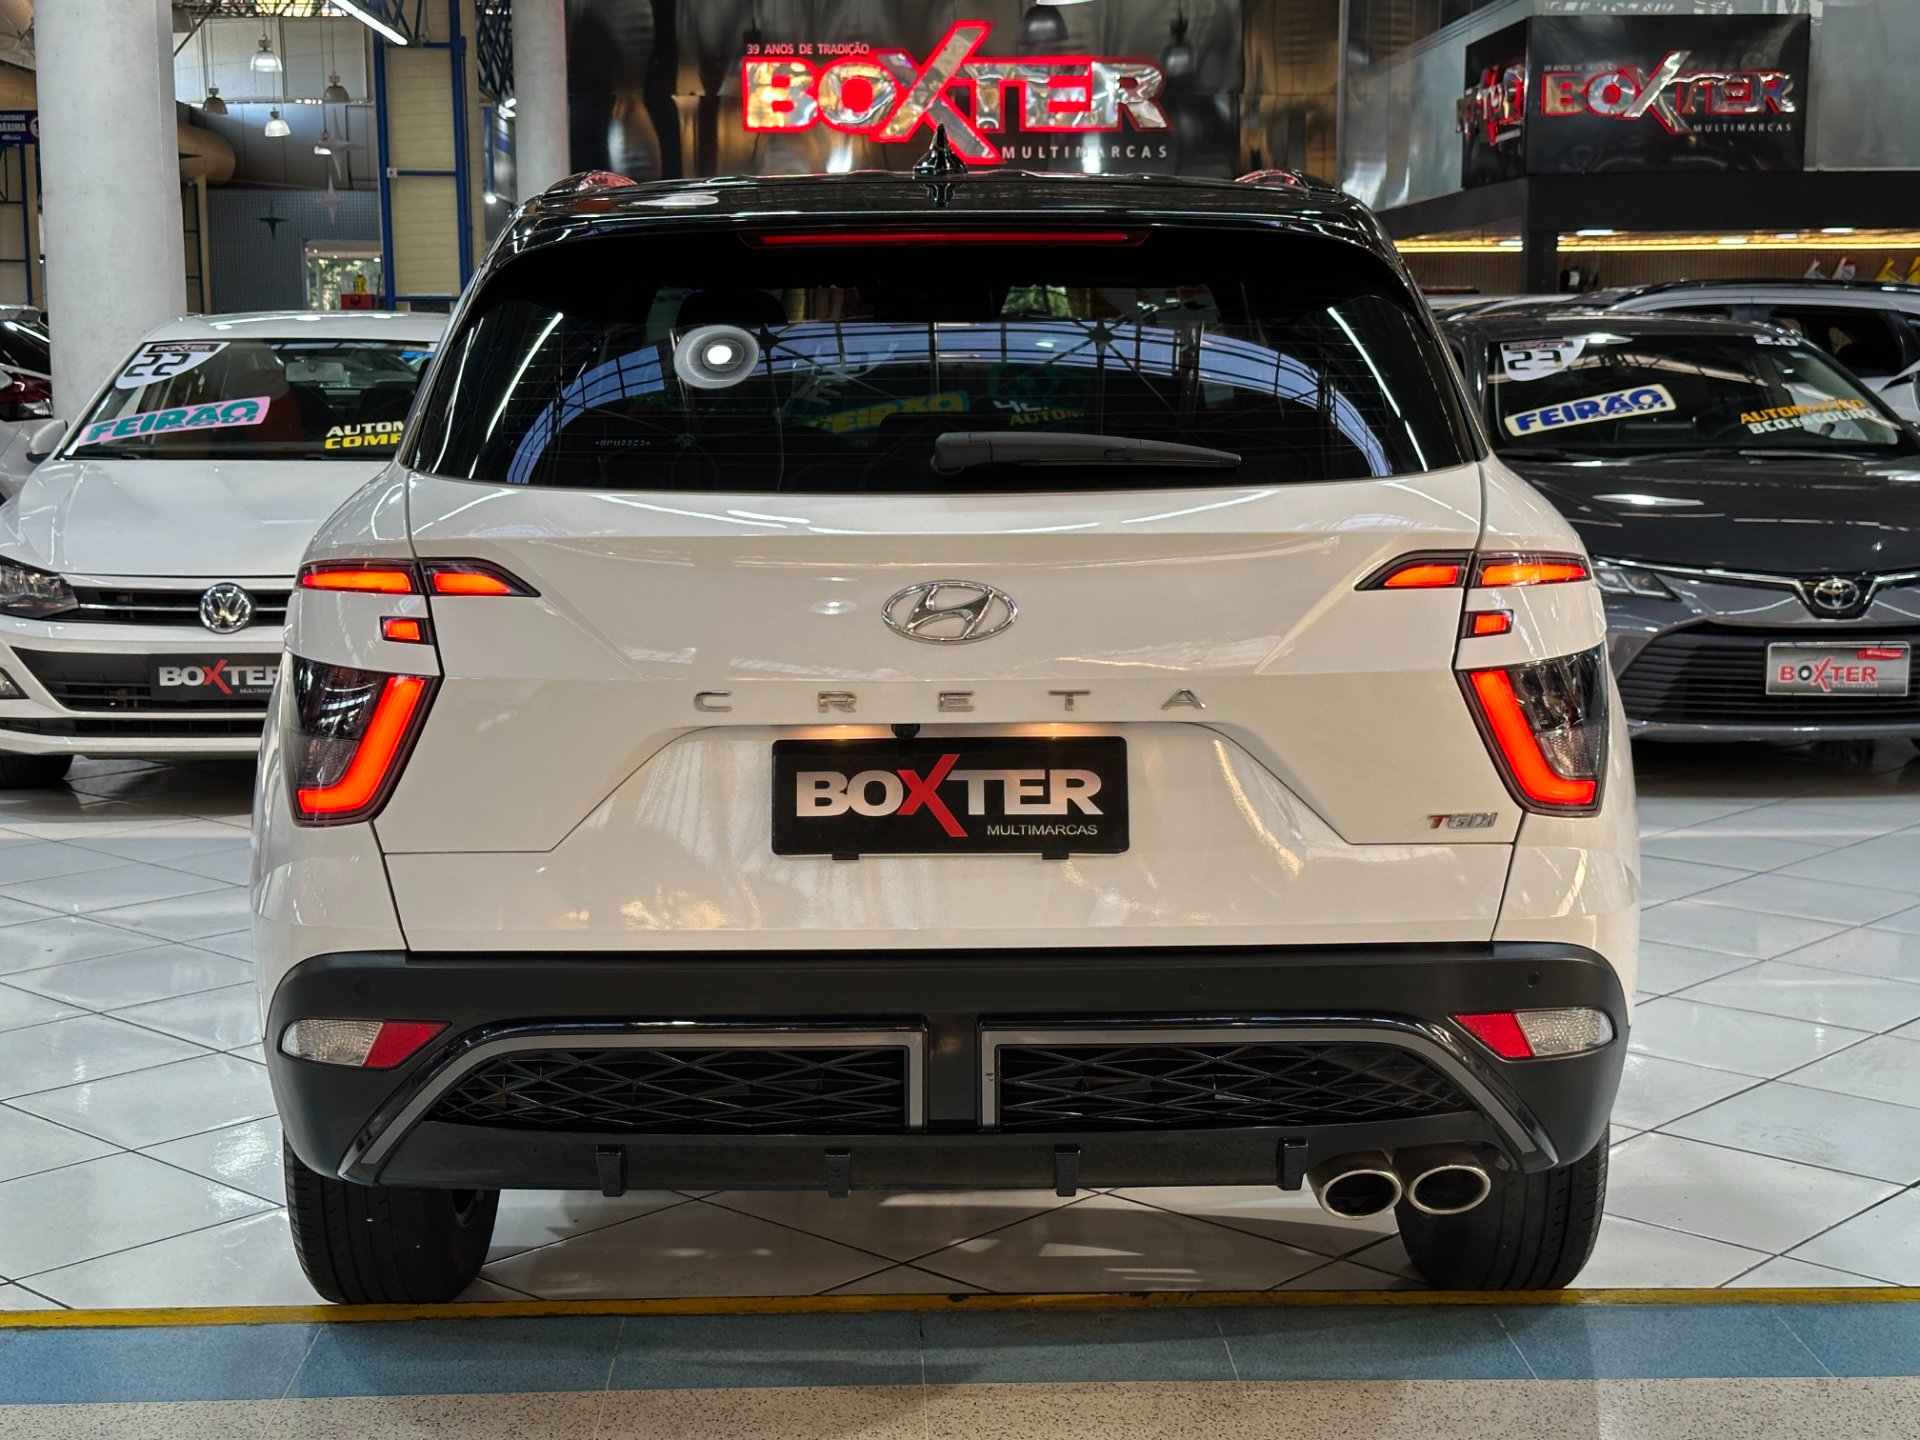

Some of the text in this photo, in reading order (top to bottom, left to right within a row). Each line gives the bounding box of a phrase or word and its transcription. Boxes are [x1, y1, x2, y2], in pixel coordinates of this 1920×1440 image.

[746, 41, 870, 56] 39 ANOS DE TRADIÇÃO
[742, 20, 1174, 165] BOXTER
[1541, 50, 1797, 135] BOXTER
[1692, 122, 1793, 133] MULTIMARCAS
[1753, 334, 1799, 347] 2.0
[124, 352, 191, 378] 22
[86, 399, 260, 442] FEIRÃO
[1515, 388, 1664, 432] FEIRÃO
[325, 433, 402, 449] COMP
[326, 420, 405, 438] AUTOM
[1778, 656, 1879, 693] BOXTER
[694, 687, 1207, 713] CRETA
[796, 753, 1104, 838] BOXTER
[986, 823, 1098, 836] MULTIMARCAS
